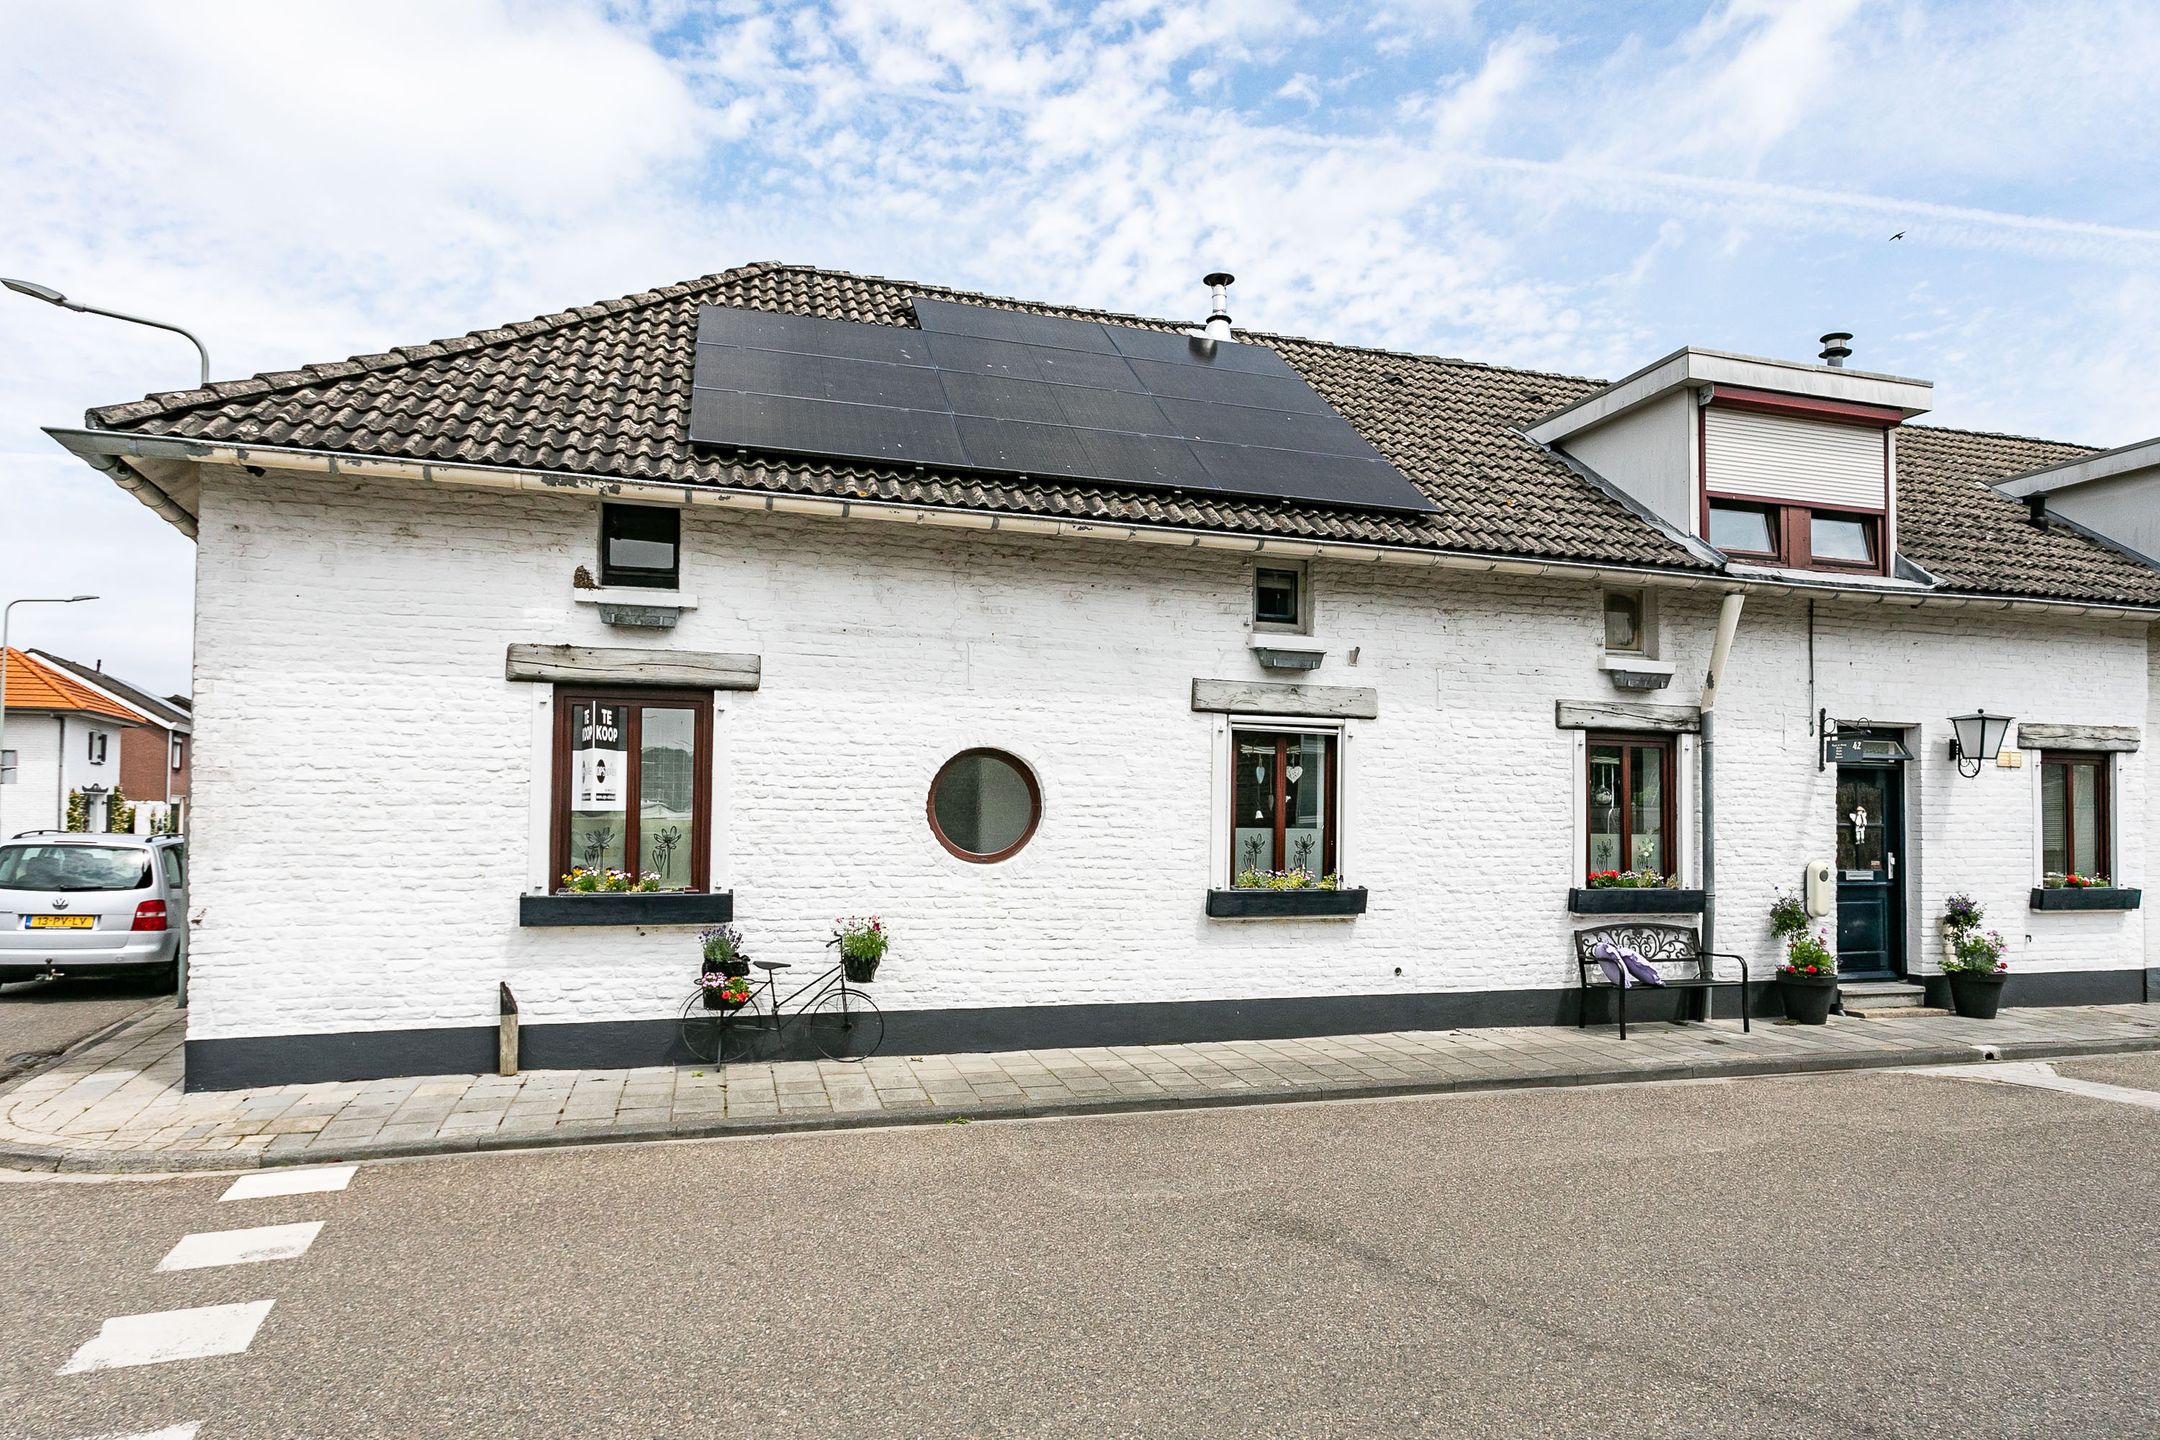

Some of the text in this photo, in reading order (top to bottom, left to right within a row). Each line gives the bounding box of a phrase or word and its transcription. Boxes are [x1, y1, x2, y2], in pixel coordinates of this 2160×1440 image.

[601, 708, 613, 725] TE
[595, 724, 618, 742] KOOP
[1852, 741, 1862, 750] 42
